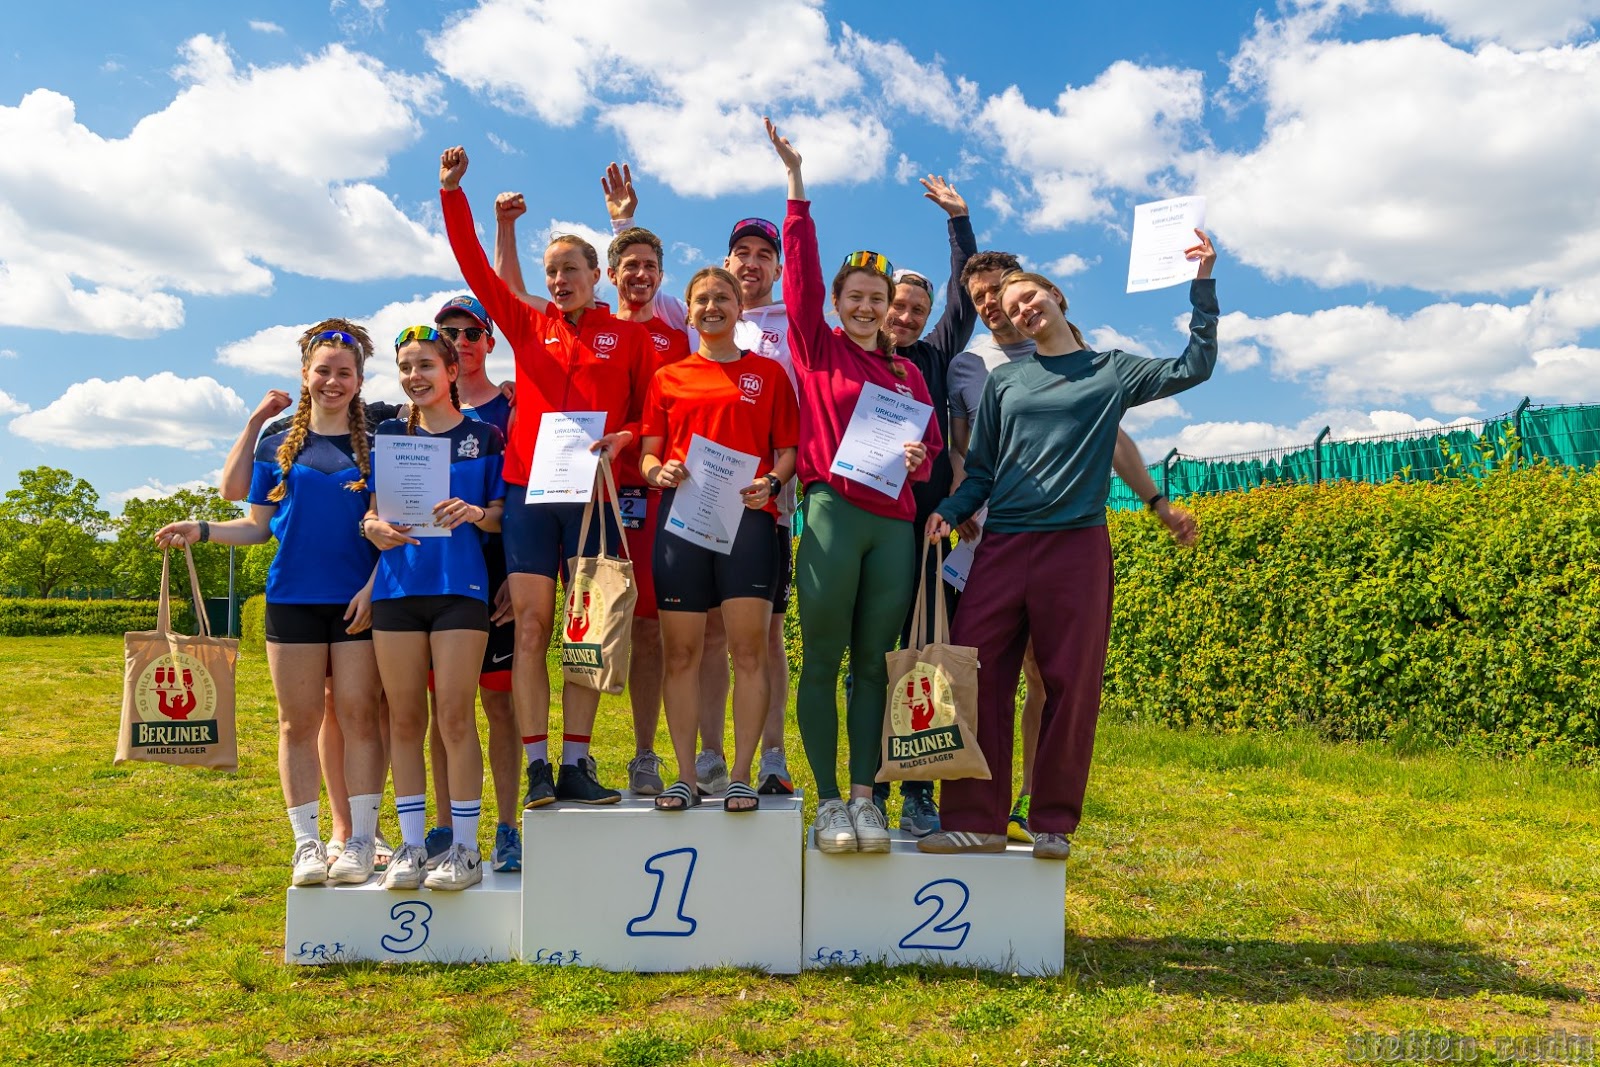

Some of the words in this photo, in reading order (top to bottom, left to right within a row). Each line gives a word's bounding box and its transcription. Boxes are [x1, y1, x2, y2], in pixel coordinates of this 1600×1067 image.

[1152, 214, 1184, 225] URKUNDE
[875, 407, 908, 422] URKUNDE
[703, 460, 734, 476] URKUNDE
[159, 656, 172, 666] SO
[196, 665, 205, 677] SO
[140, 672, 152, 696] MILD
[203, 678, 214, 712] BERLIN
[893, 687, 904, 710] MILD
[140, 699, 149, 712] SO
[894, 714, 901, 726] SO
[138, 724, 212, 745] BERLINER
[892, 732, 957, 757] BERLINER
[900, 759, 927, 769] MILDES
[929, 753, 954, 763] LAGER
[626, 848, 698, 936] 1
[898, 878, 971, 950] 2
[380, 900, 433, 954] 3
